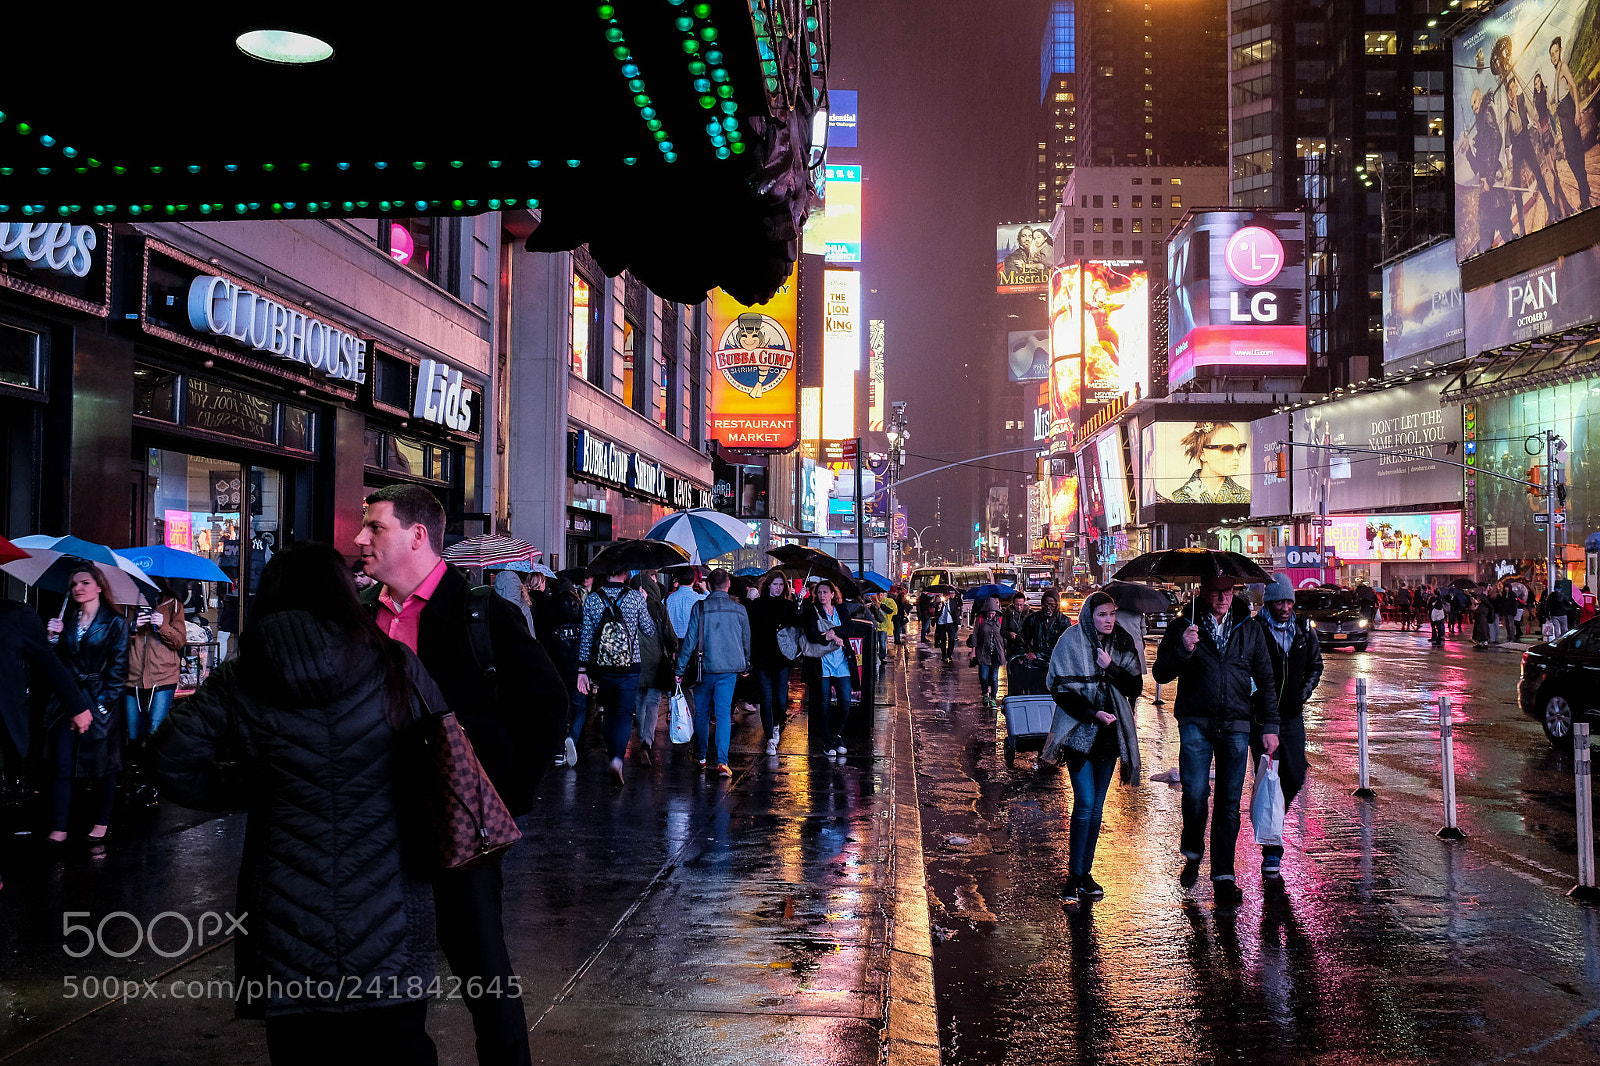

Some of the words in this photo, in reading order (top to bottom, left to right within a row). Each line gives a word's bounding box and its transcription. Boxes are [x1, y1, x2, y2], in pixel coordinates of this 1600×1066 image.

[829, 113, 856, 122] dential
[999, 268, 1052, 286] Misérabl
[830, 293, 846, 301] THE
[1431, 287, 1462, 315] PAN
[1507, 271, 1558, 318] PAN
[827, 302, 849, 316] LION
[1229, 291, 1278, 322] LG
[825, 316, 852, 333] KING
[1517, 313, 1543, 327] OCTOBER
[1543, 310, 1548, 320] 9
[188, 275, 367, 385] CLUBHOUSE
[718, 350, 757, 367] BUBBA
[759, 349, 792, 367] GUMP
[730, 366, 758, 374] SHRIMP
[414, 359, 472, 432] Lids
[714, 420, 794, 428] RESTAURANT
[1371, 417, 1400, 436] DON'T
[1400, 413, 1420, 430] LET
[1420, 409, 1443, 426] THE
[728, 433, 780, 442] MARKET
[1368, 434, 1394, 451] NAME
[1395, 430, 1422, 447] FOOL
[1422, 426, 1446, 443] YOU.
[582, 429, 608, 479] BUBBA
[634, 451, 657, 495] SHRIMP
